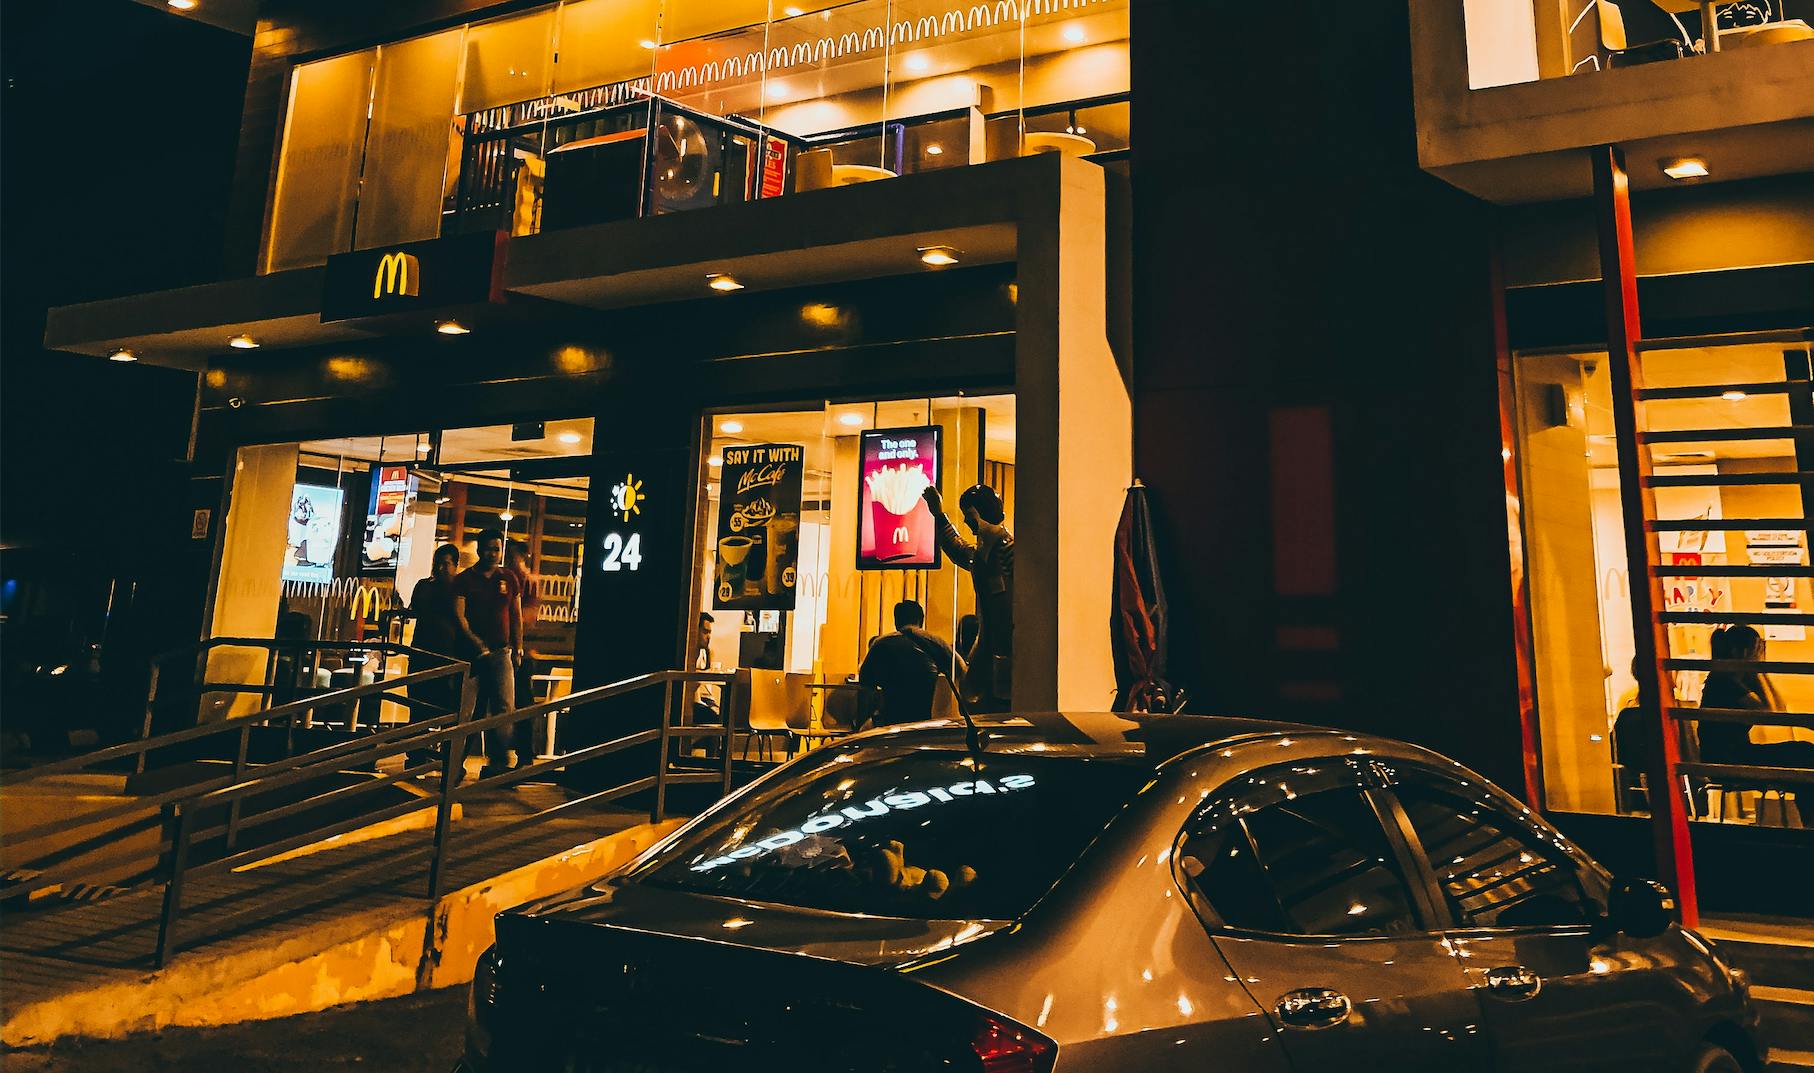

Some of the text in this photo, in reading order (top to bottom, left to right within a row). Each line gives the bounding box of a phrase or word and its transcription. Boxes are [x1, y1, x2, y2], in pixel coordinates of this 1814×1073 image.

[880, 439, 917, 450] The one
[726, 446, 799, 465] SAY IT WITH
[878, 448, 919, 460] and only.
[602, 533, 642, 572] 24
